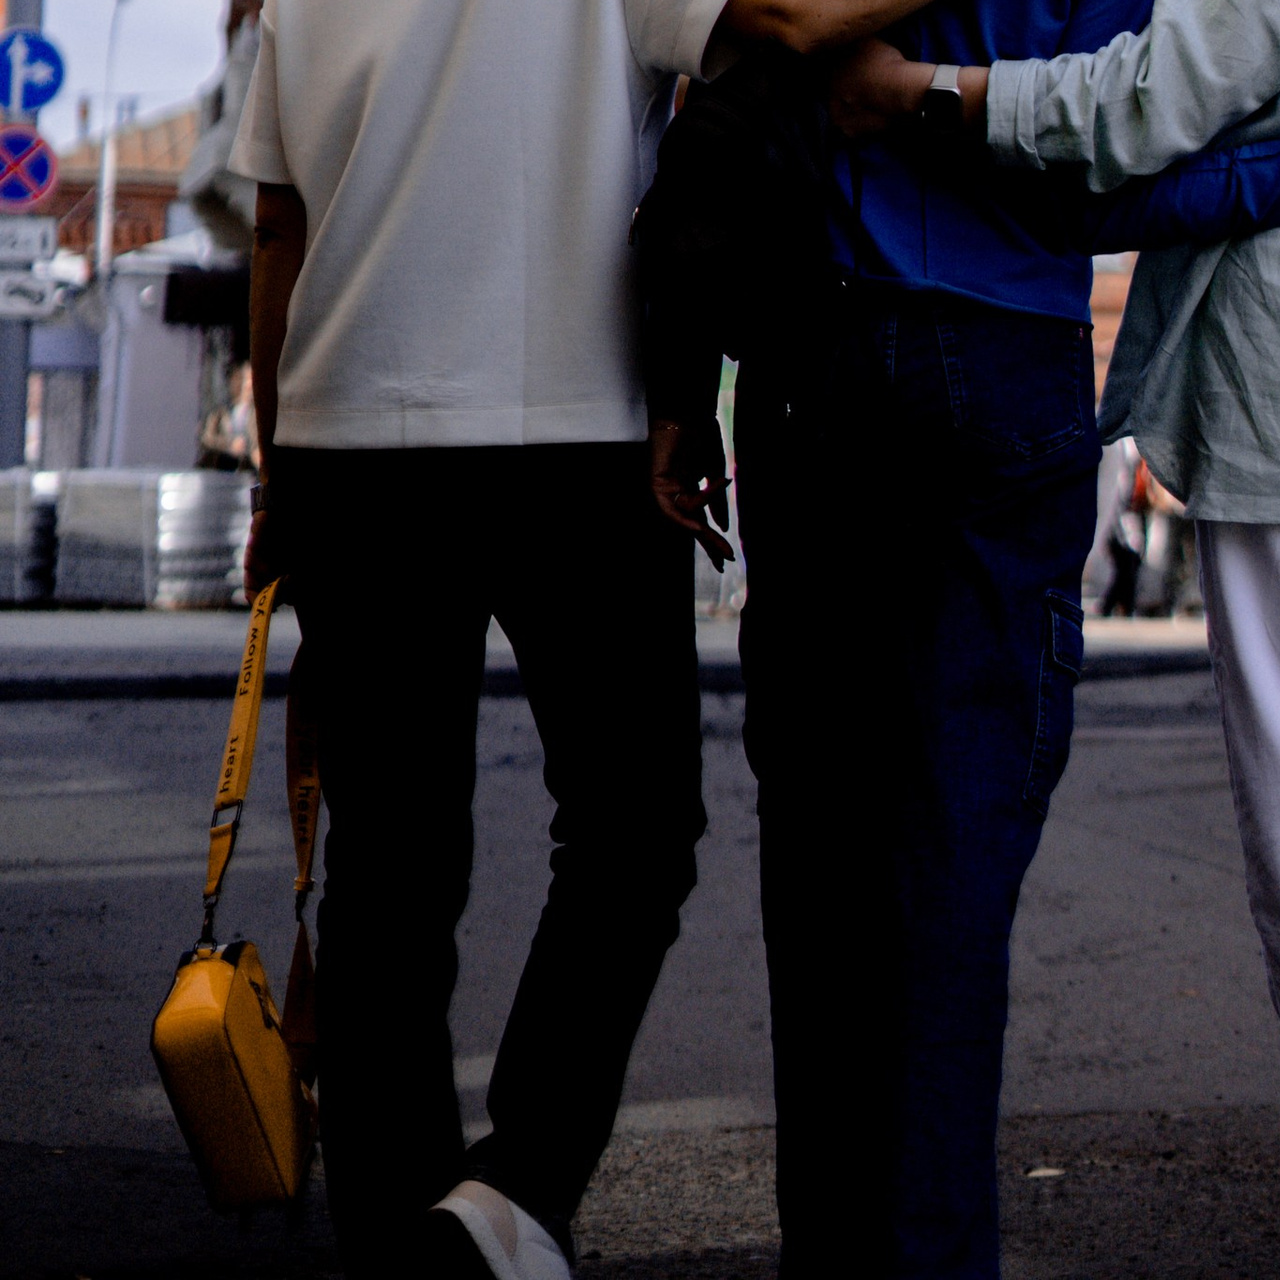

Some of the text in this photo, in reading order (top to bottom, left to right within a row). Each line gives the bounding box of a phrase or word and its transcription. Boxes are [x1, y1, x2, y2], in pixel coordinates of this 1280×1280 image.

[219, 736, 239, 794] heart
[240, 628, 259, 697] Follow
[297, 786, 315, 844] heart
